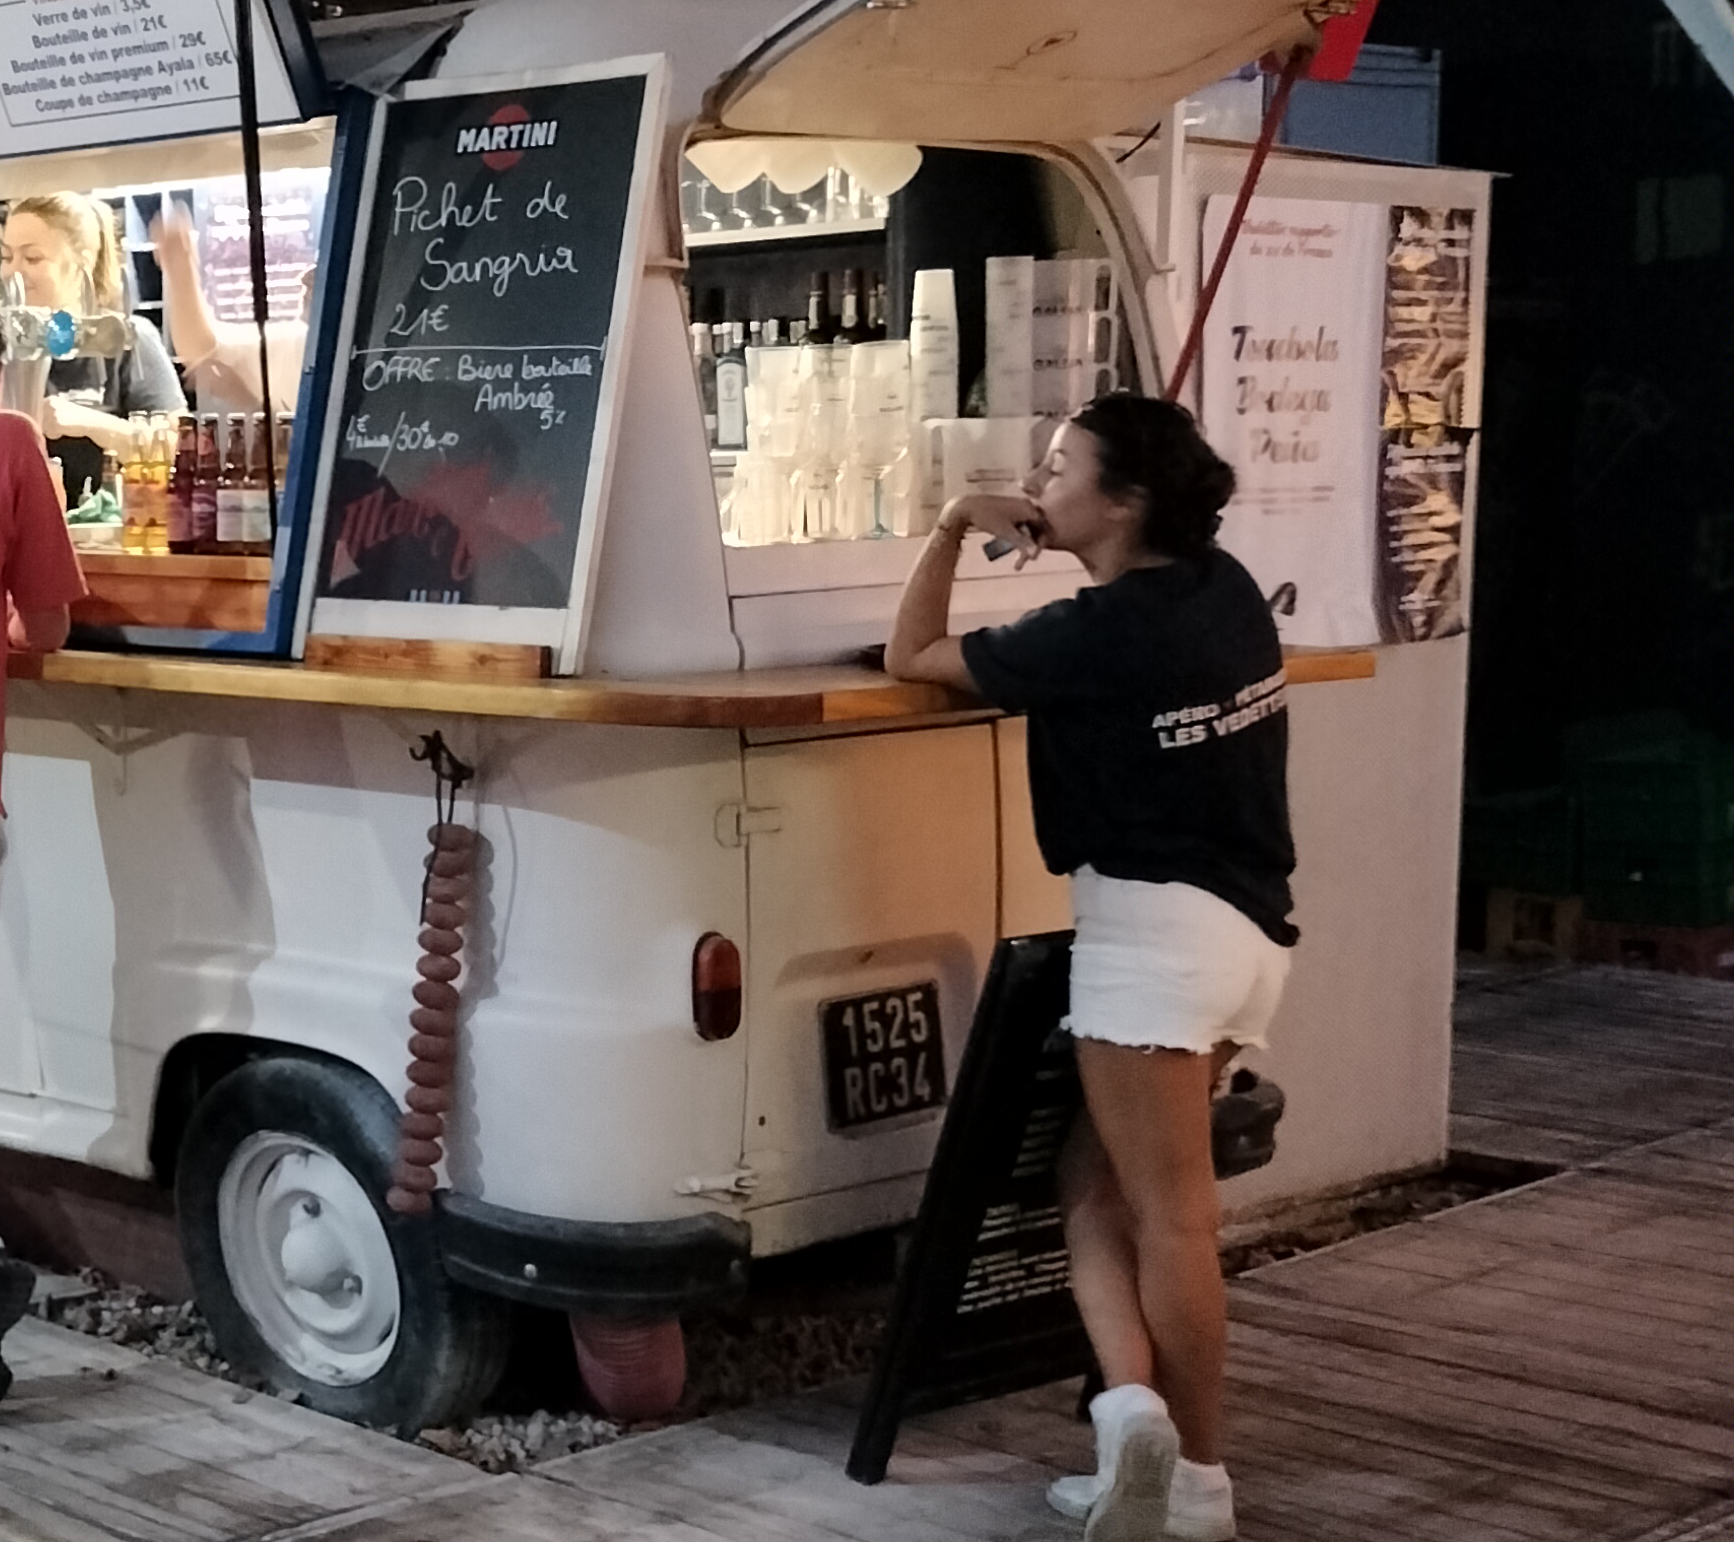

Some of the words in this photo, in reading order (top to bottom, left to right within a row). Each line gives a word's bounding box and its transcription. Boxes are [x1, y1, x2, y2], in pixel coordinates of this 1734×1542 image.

[32, 12, 68, 27] Verre
[72, 7, 88, 21] de
[90, 3, 111, 18] vin
[32, 29, 89, 49] Bouteille
[92, 25, 108, 40] de
[111, 21, 132, 36] vin
[141, 14, 167, 32] 21€
[10, 53, 67, 74] Bouteille
[69, 50, 86, 64] de
[88, 47, 109, 61] vin
[111, 38, 169, 61] premium
[179, 31, 206, 48] 29€
[2, 76, 57, 96] Bouteille
[59, 74, 76, 88] de
[79, 60, 153, 85] champagne
[157, 54, 195, 76] Ayala
[204, 50, 232, 67] 65€
[35, 95, 75, 113] Coupe
[78, 90, 93, 107] de
[97, 79, 172, 102] champagne
[182, 76, 209, 92] 11€
[457, 121, 557, 153] MARTINI
[392, 176, 502, 236] Pichet
[526, 180, 568, 219] de
[420, 238, 578, 297] Sangria
[390, 303, 449, 335] 21€
[1158, 725, 1208, 749] LES
[842, 992, 928, 1057] 1525
[843, 1052, 931, 1120] RC34
